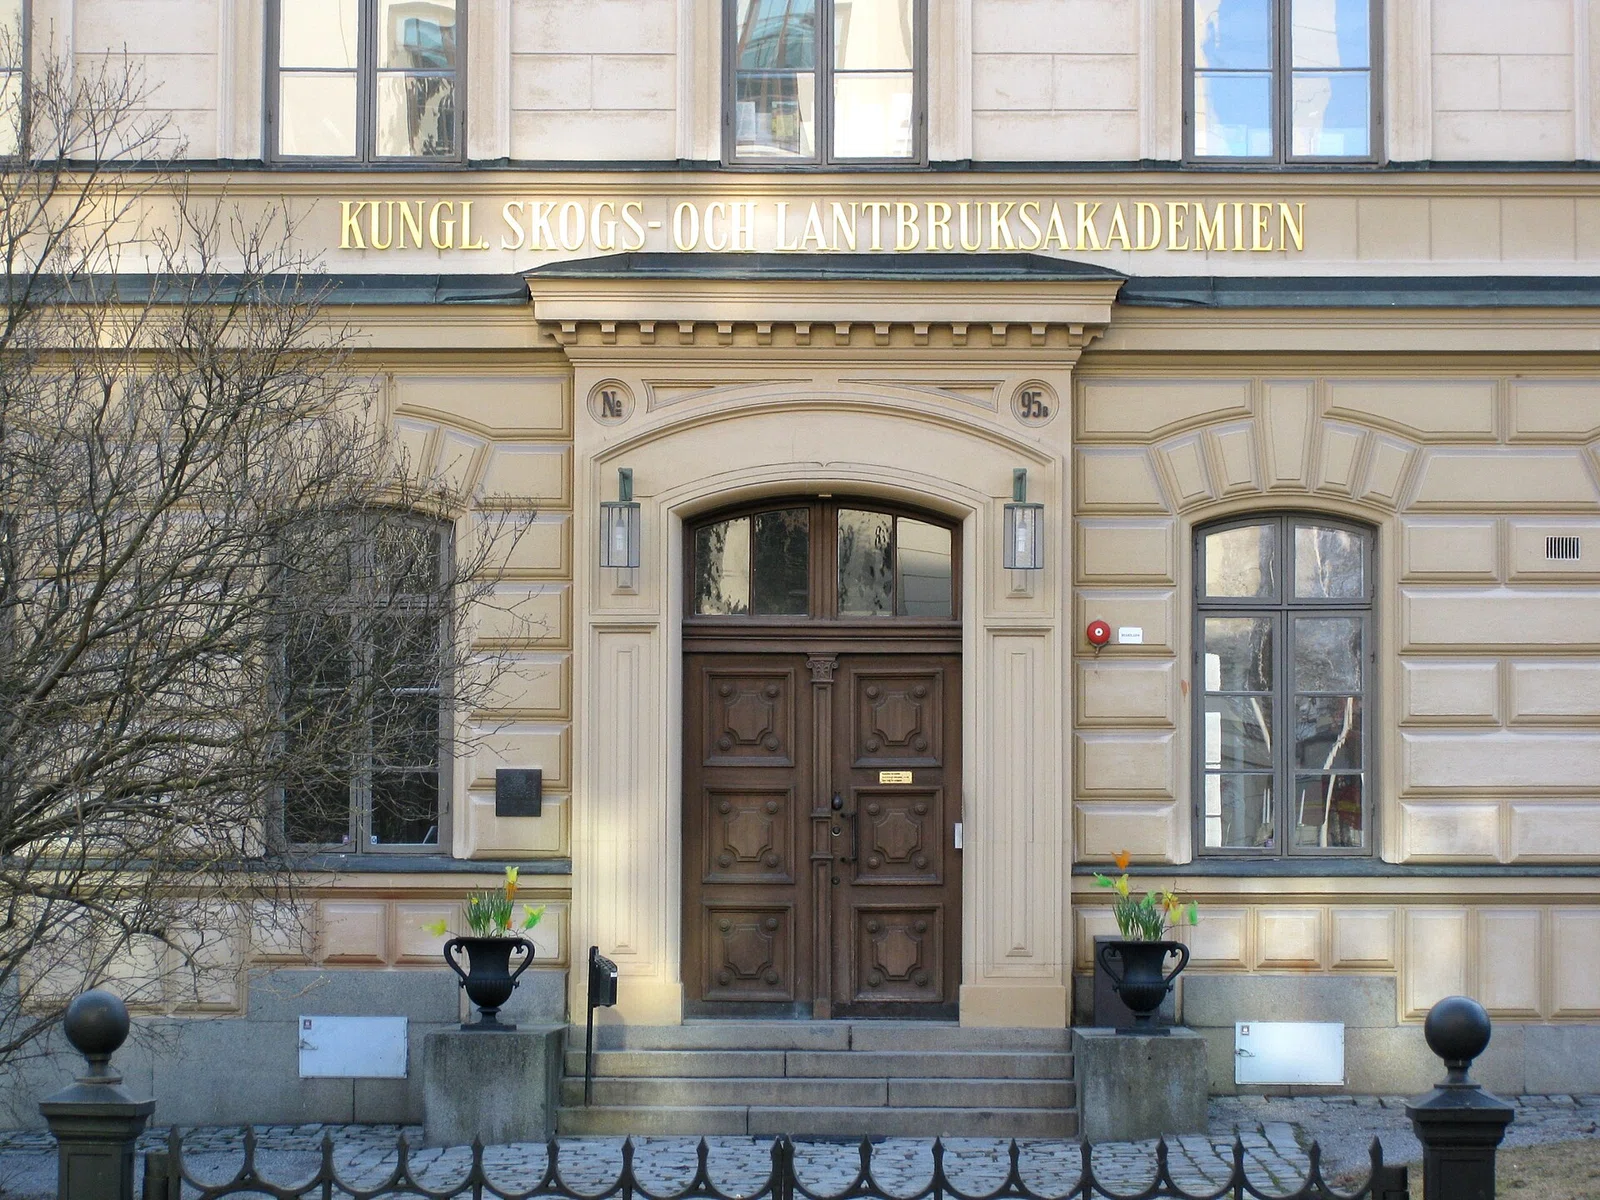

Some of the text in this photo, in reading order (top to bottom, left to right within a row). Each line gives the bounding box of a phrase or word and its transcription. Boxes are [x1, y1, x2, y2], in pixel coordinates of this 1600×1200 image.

[338, 200, 1306, 252] KUNGL. SKOGS- OCH LANTBRUKSAKADEMIEN
